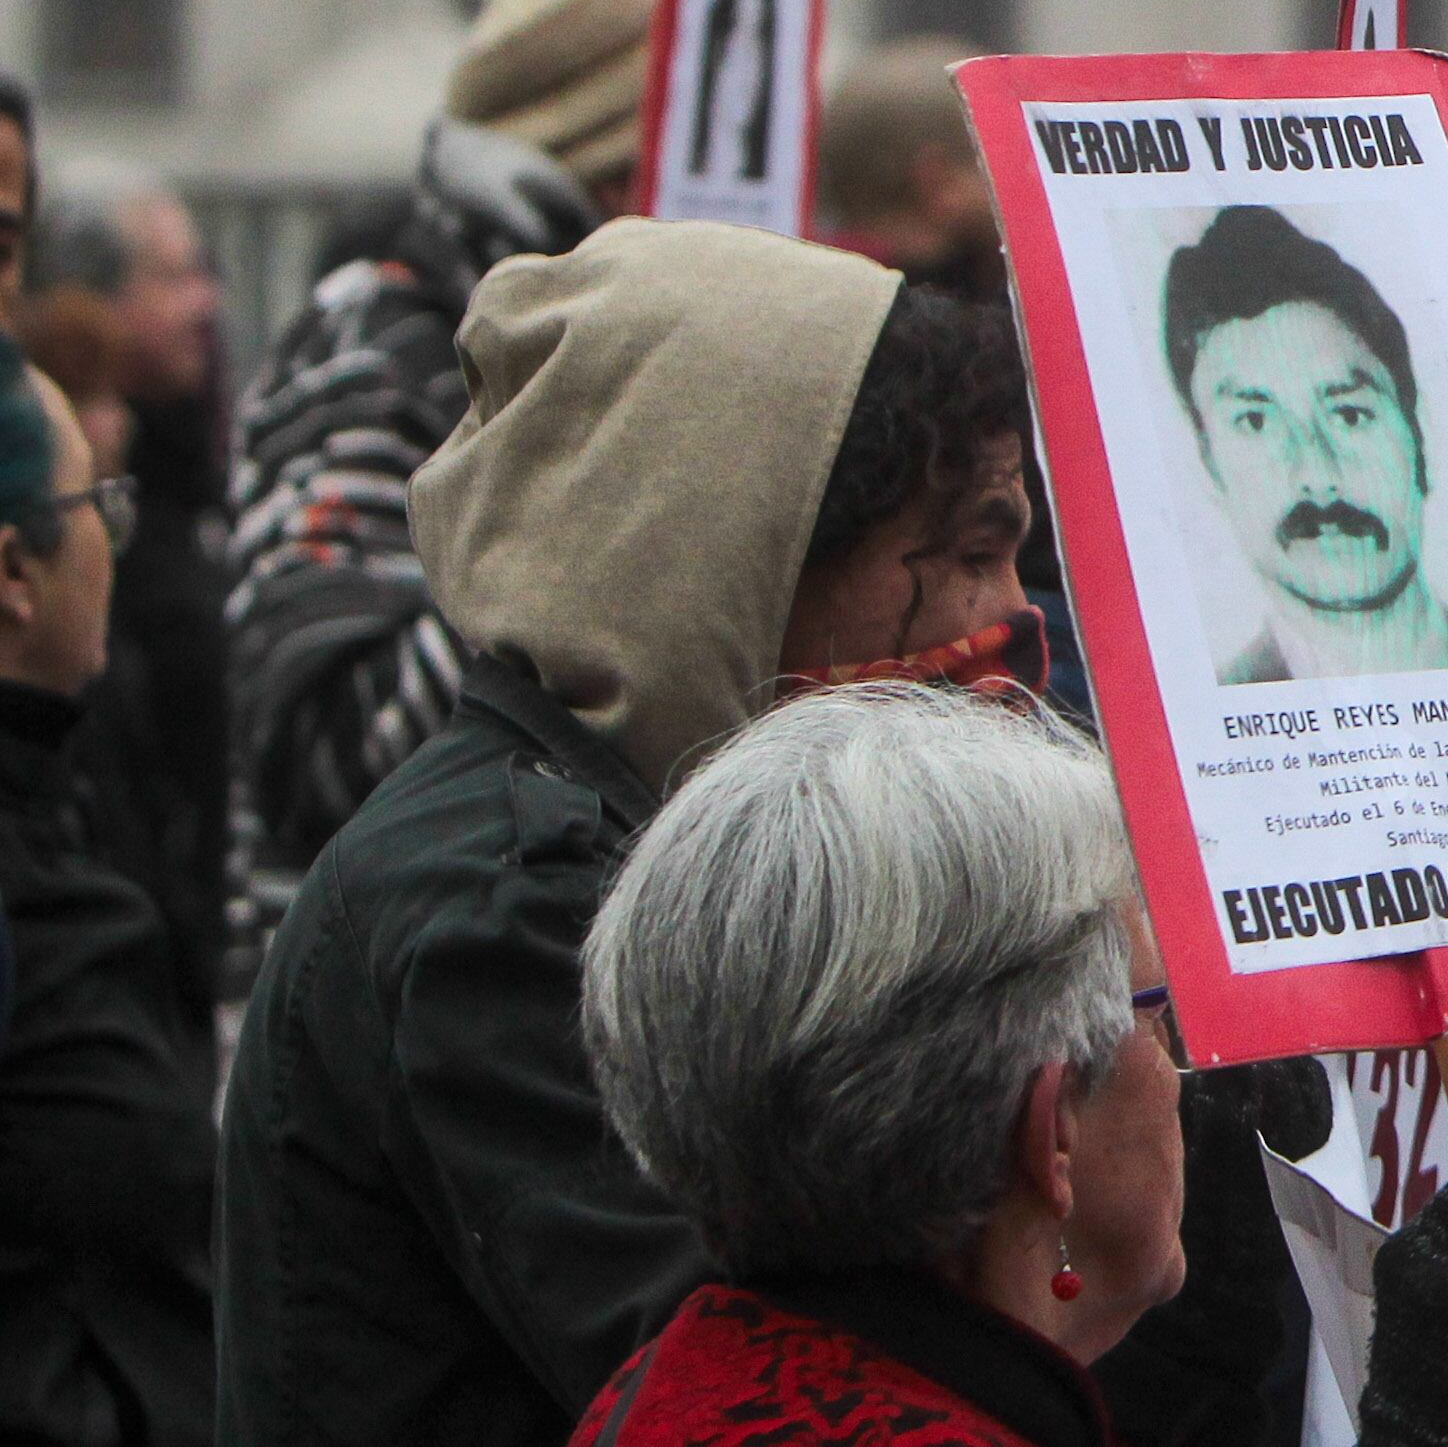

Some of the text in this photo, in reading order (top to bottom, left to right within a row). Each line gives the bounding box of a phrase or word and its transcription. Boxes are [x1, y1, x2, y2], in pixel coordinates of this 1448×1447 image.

[1035, 113, 1424, 174] VERDAD Y JUSTICIA
[1223, 709, 1321, 740] ENRIQUE
[1333, 703, 1400, 730] REYES
[1197, 756, 1275, 778] Mecánico
[1283, 752, 1301, 771] de
[1308, 743, 1403, 769] Mantención
[1409, 742, 1426, 760] de
[1415, 770, 1439, 788] del
[1265, 808, 1352, 837] Ejecutado
[1362, 802, 1385, 821] el
[1394, 800, 1405, 816] 6
